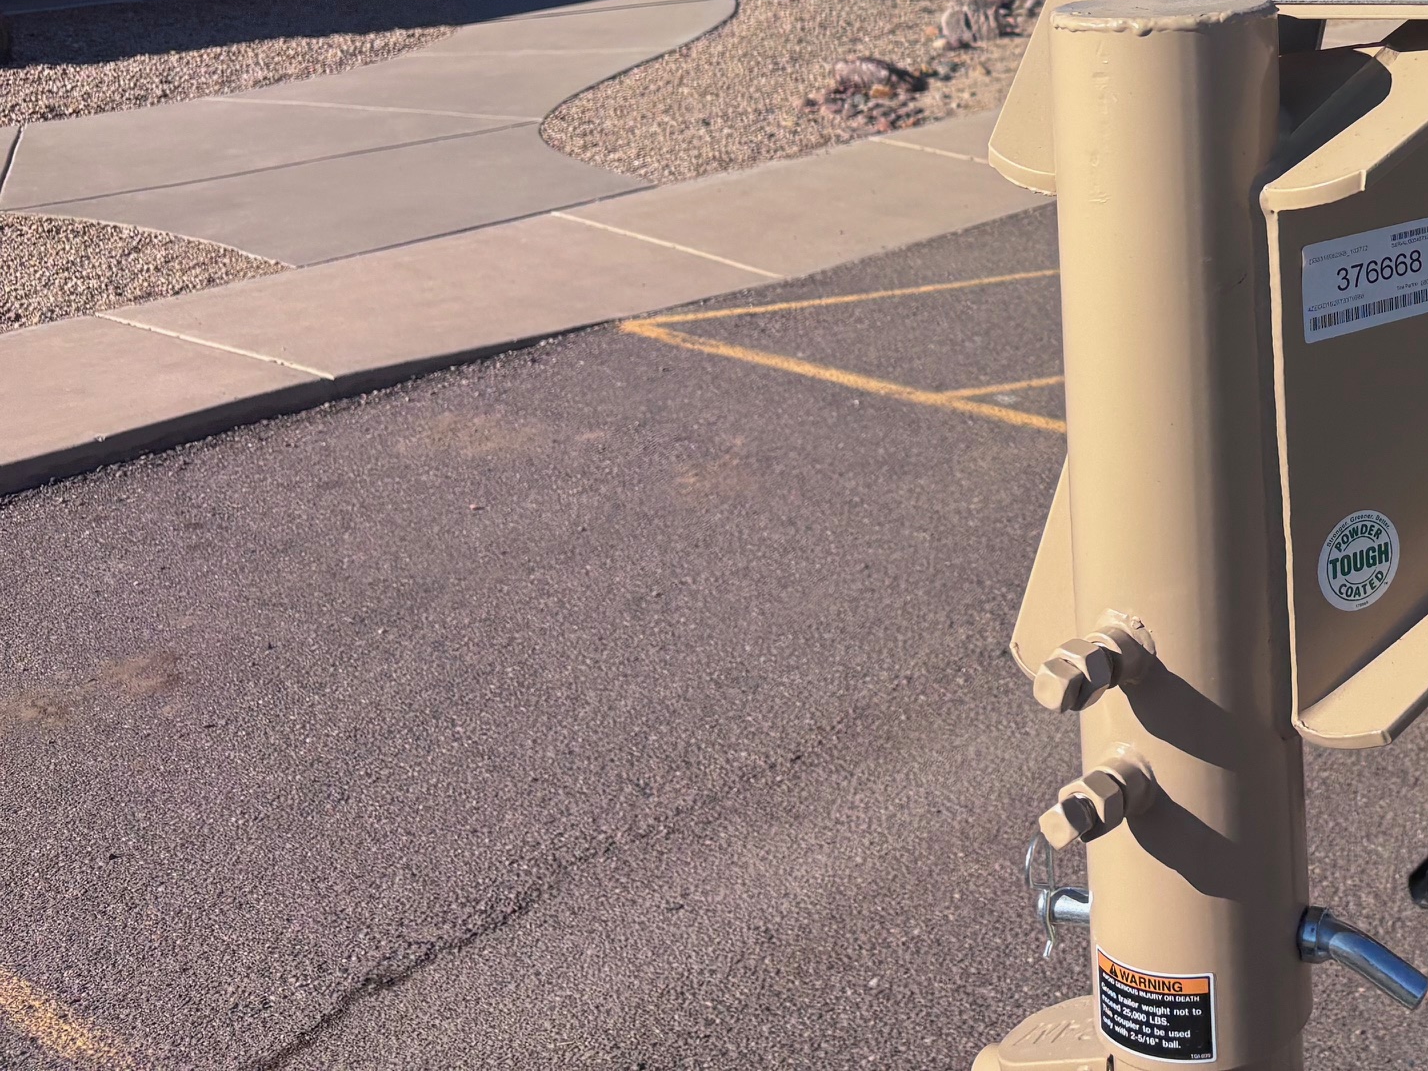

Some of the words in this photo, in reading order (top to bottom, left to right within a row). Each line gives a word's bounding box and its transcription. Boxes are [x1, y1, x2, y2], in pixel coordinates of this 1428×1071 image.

[1336, 249, 1422, 292] 376668
[1335, 523, 1383, 553] POWDER
[1329, 541, 1390, 580] TOUGH
[1338, 570, 1384, 598] COATED
[1120, 968, 1183, 993] WARNING
[1118, 994, 1139, 1009] trailer
[1141, 1003, 1170, 1016] weight
[1174, 1007, 1189, 1016] not
[1192, 1007, 1202, 1016] to
[1139, 991, 1162, 1001] INJURY
[1114, 1014, 1140, 1031] coupler
[1142, 1024, 1151, 1034] to
[1154, 1028, 1165, 1037] be
[1168, 1030, 1191, 1038] used
[1122, 1007, 1147, 1022] 25,000
[1149, 1016, 1170, 1026] LBS.
[1162, 1039, 1182, 1049] ball.
